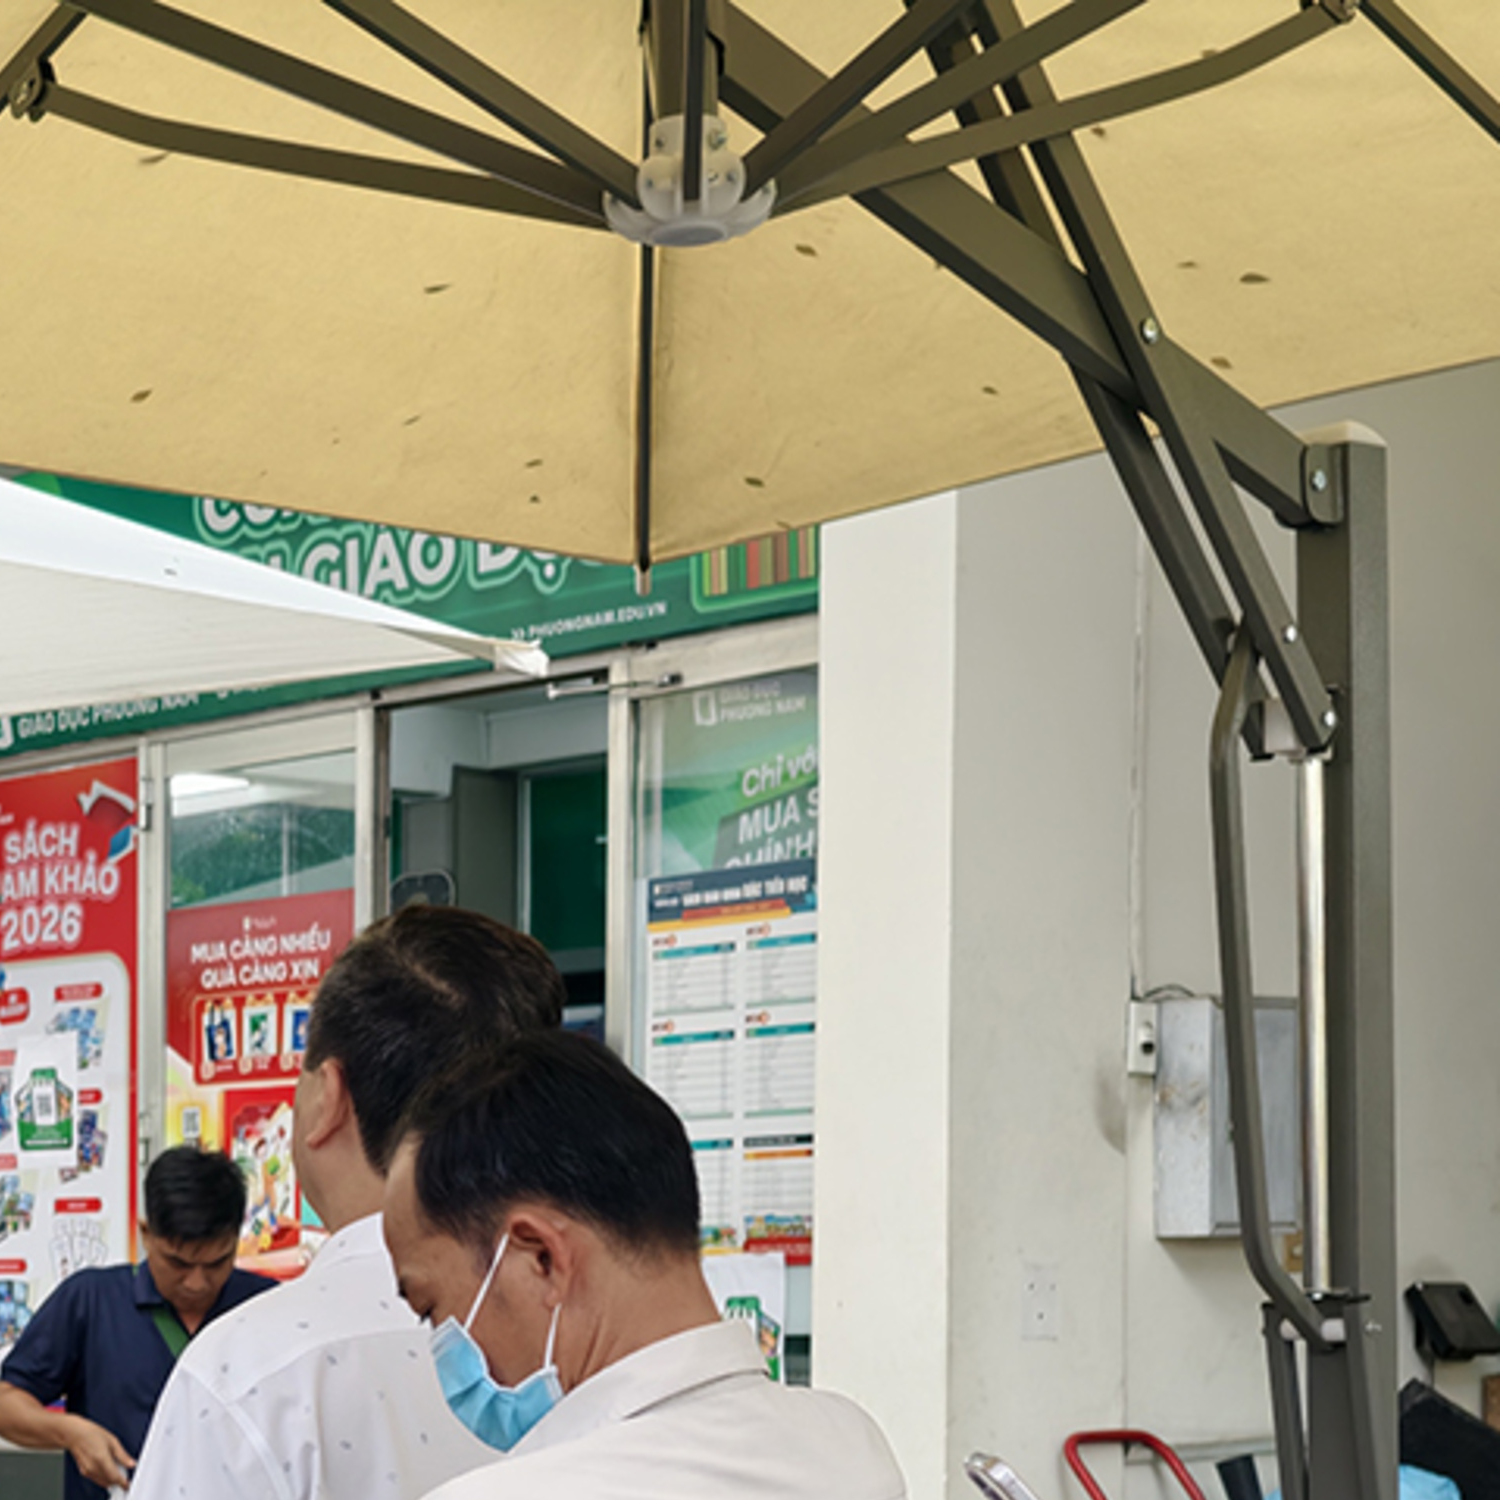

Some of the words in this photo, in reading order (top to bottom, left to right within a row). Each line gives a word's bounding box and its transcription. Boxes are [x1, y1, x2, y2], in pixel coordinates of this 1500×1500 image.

[741, 752, 784, 798] Chỉ
[2, 817, 80, 866] SÁCH
[738, 795, 801, 845] MUA
[43, 849, 120, 898] KHẢO
[0, 902, 82, 952] 2026
[190, 939, 228, 964] MUA
